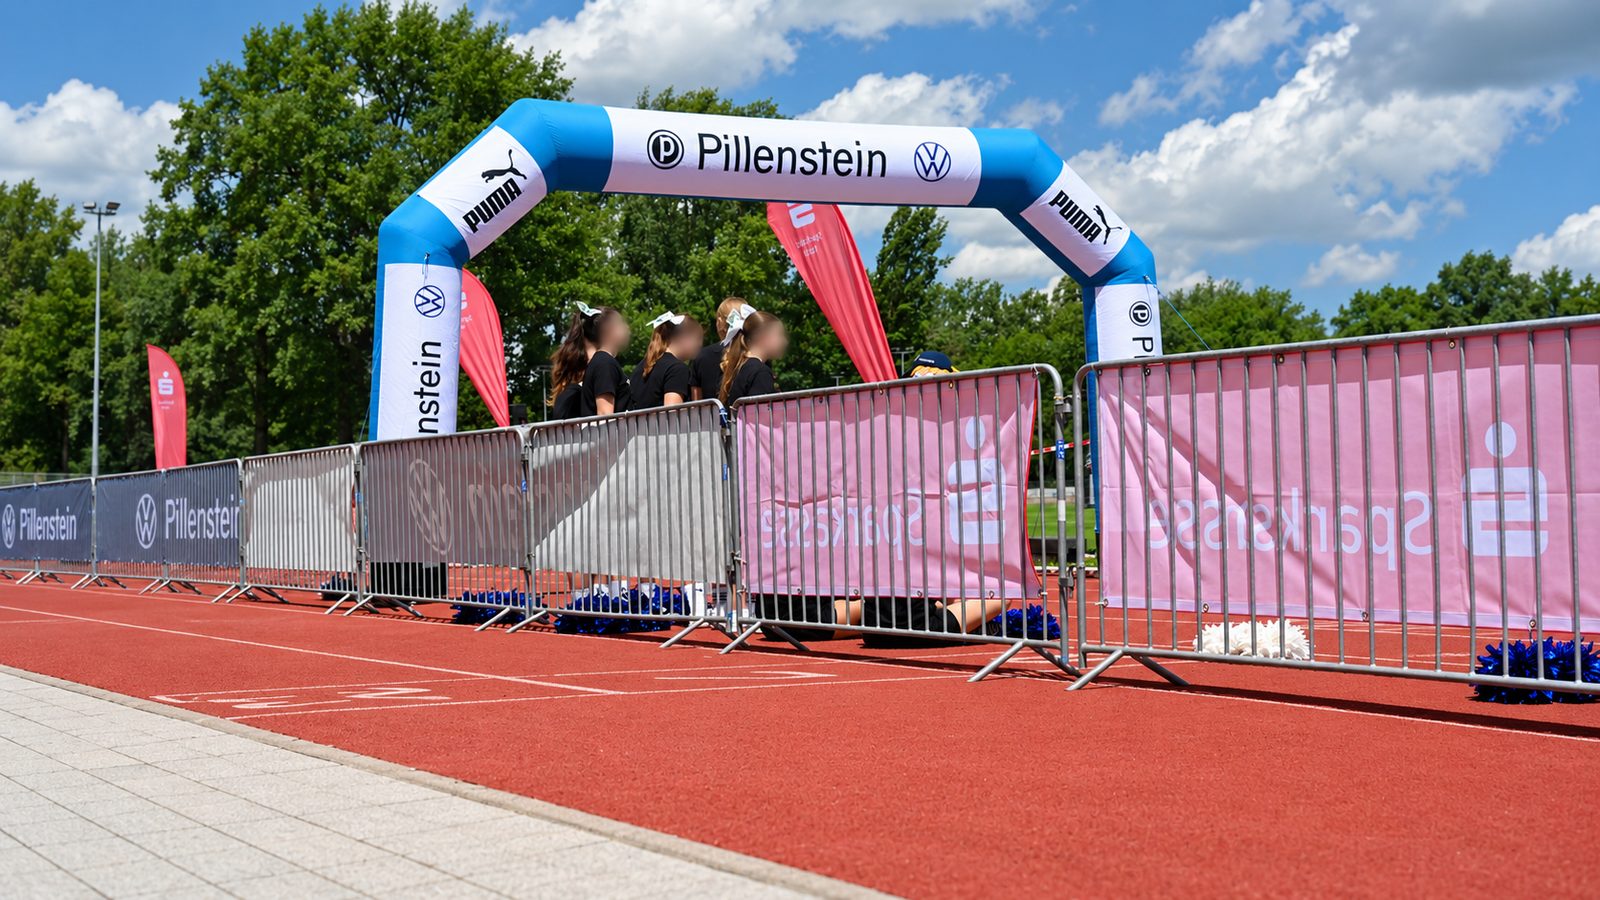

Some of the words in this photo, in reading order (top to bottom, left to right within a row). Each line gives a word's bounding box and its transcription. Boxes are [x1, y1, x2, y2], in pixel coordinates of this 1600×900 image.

[697, 132, 888, 178] Pillenstein
[462, 177, 524, 234] PUMA
[1048, 189, 1103, 243] PUMA
[412, 340, 443, 435] nstein
[19, 505, 77, 541] Pillenstein
